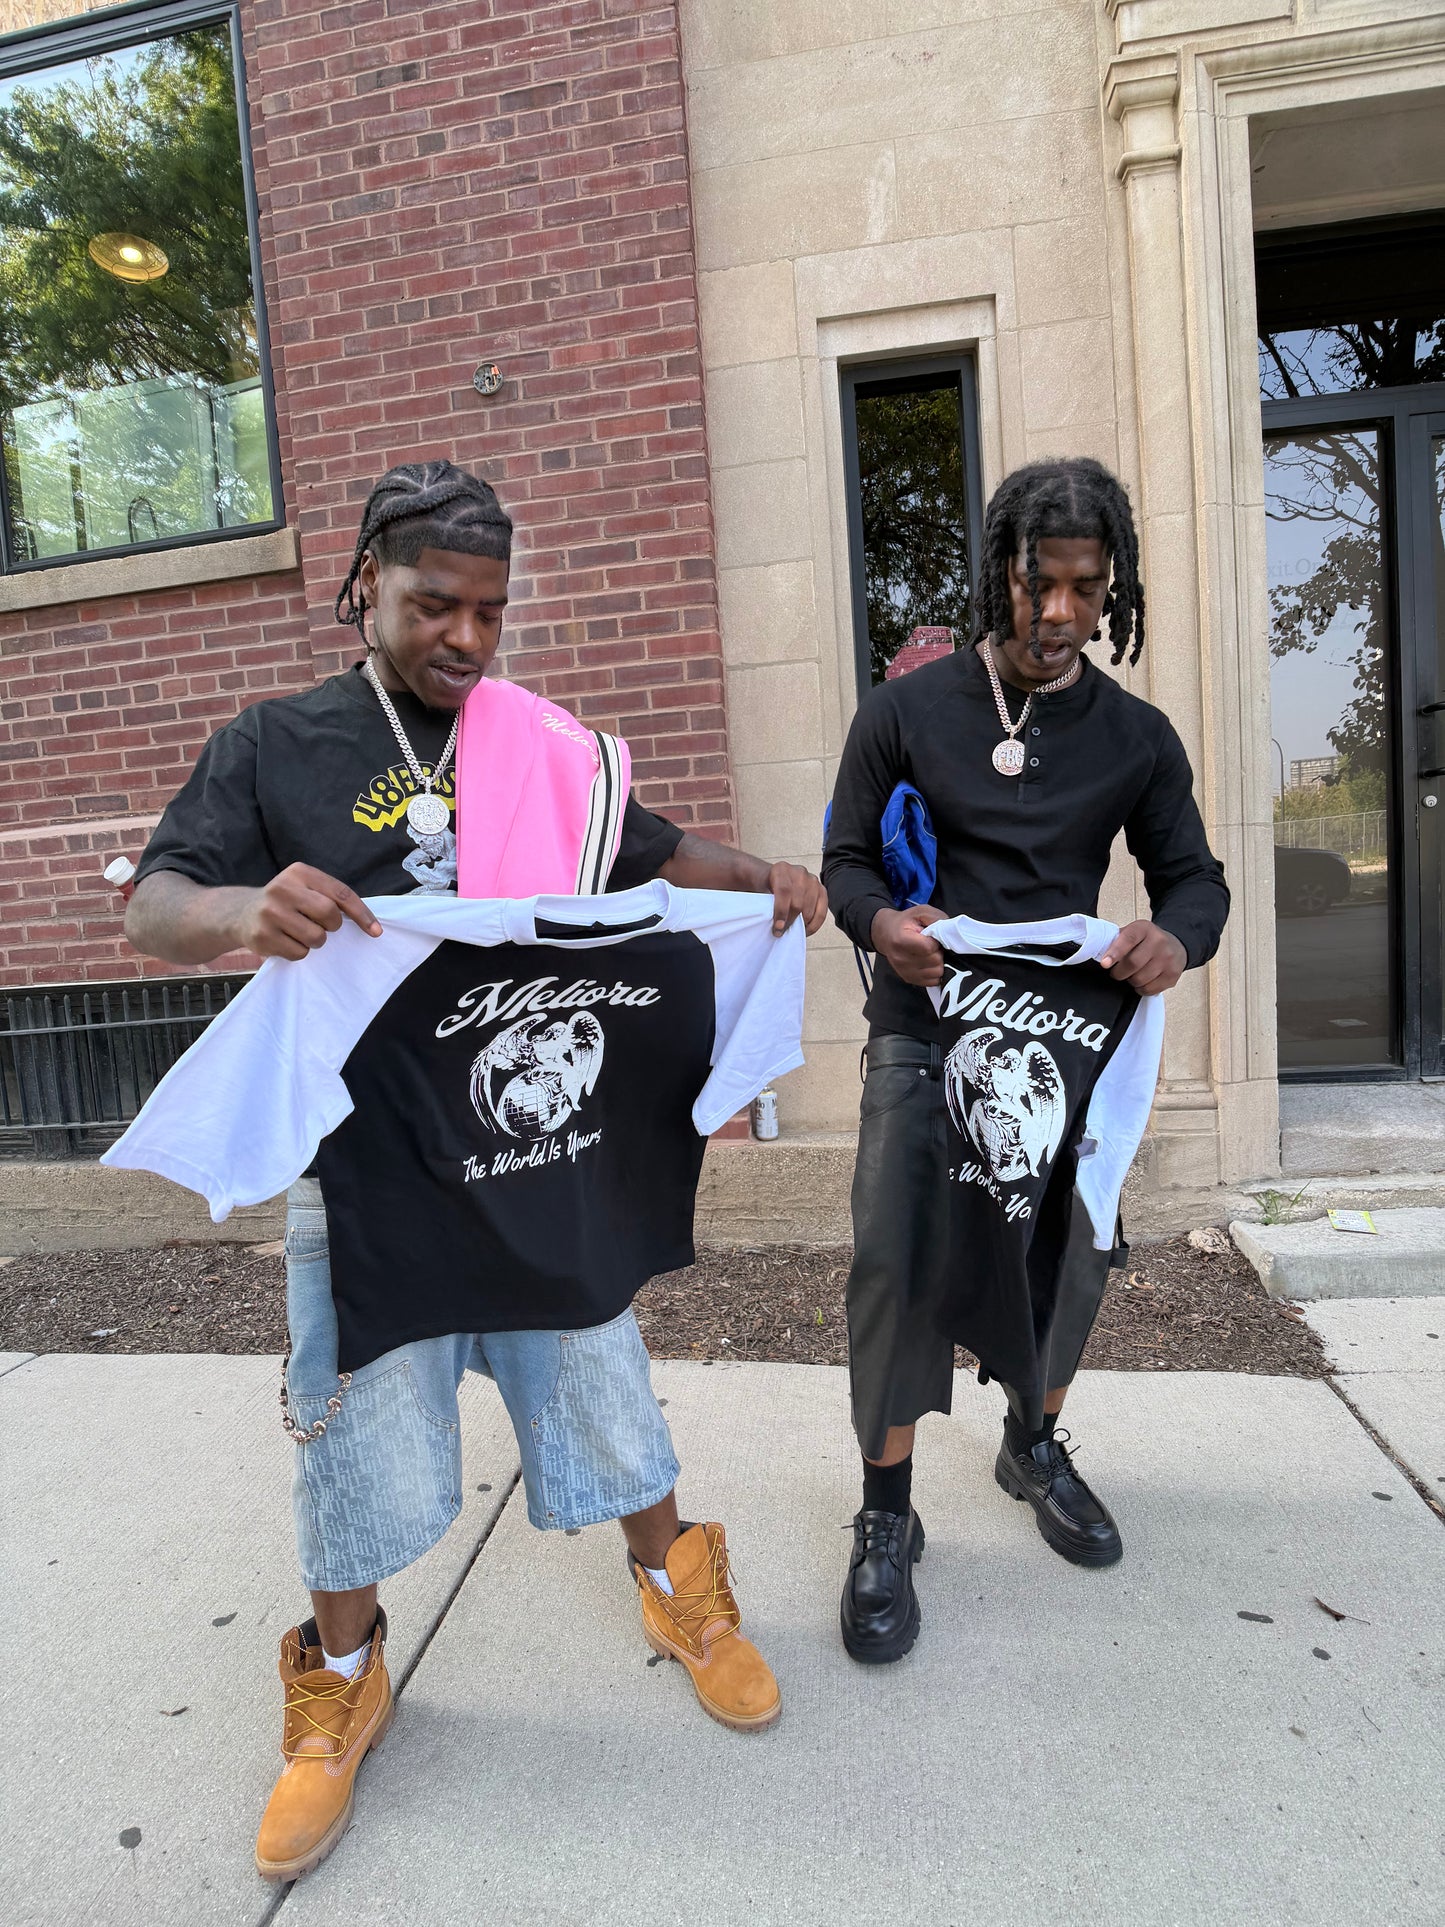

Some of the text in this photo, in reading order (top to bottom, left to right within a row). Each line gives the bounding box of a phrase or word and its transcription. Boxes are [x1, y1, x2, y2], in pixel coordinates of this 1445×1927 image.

[1267, 560, 1293, 578] xit
[435, 976, 662, 1038] Meliora
[940, 963, 1111, 1052] Meliora
[462, 1129, 602, 1182] The World Is Yours
